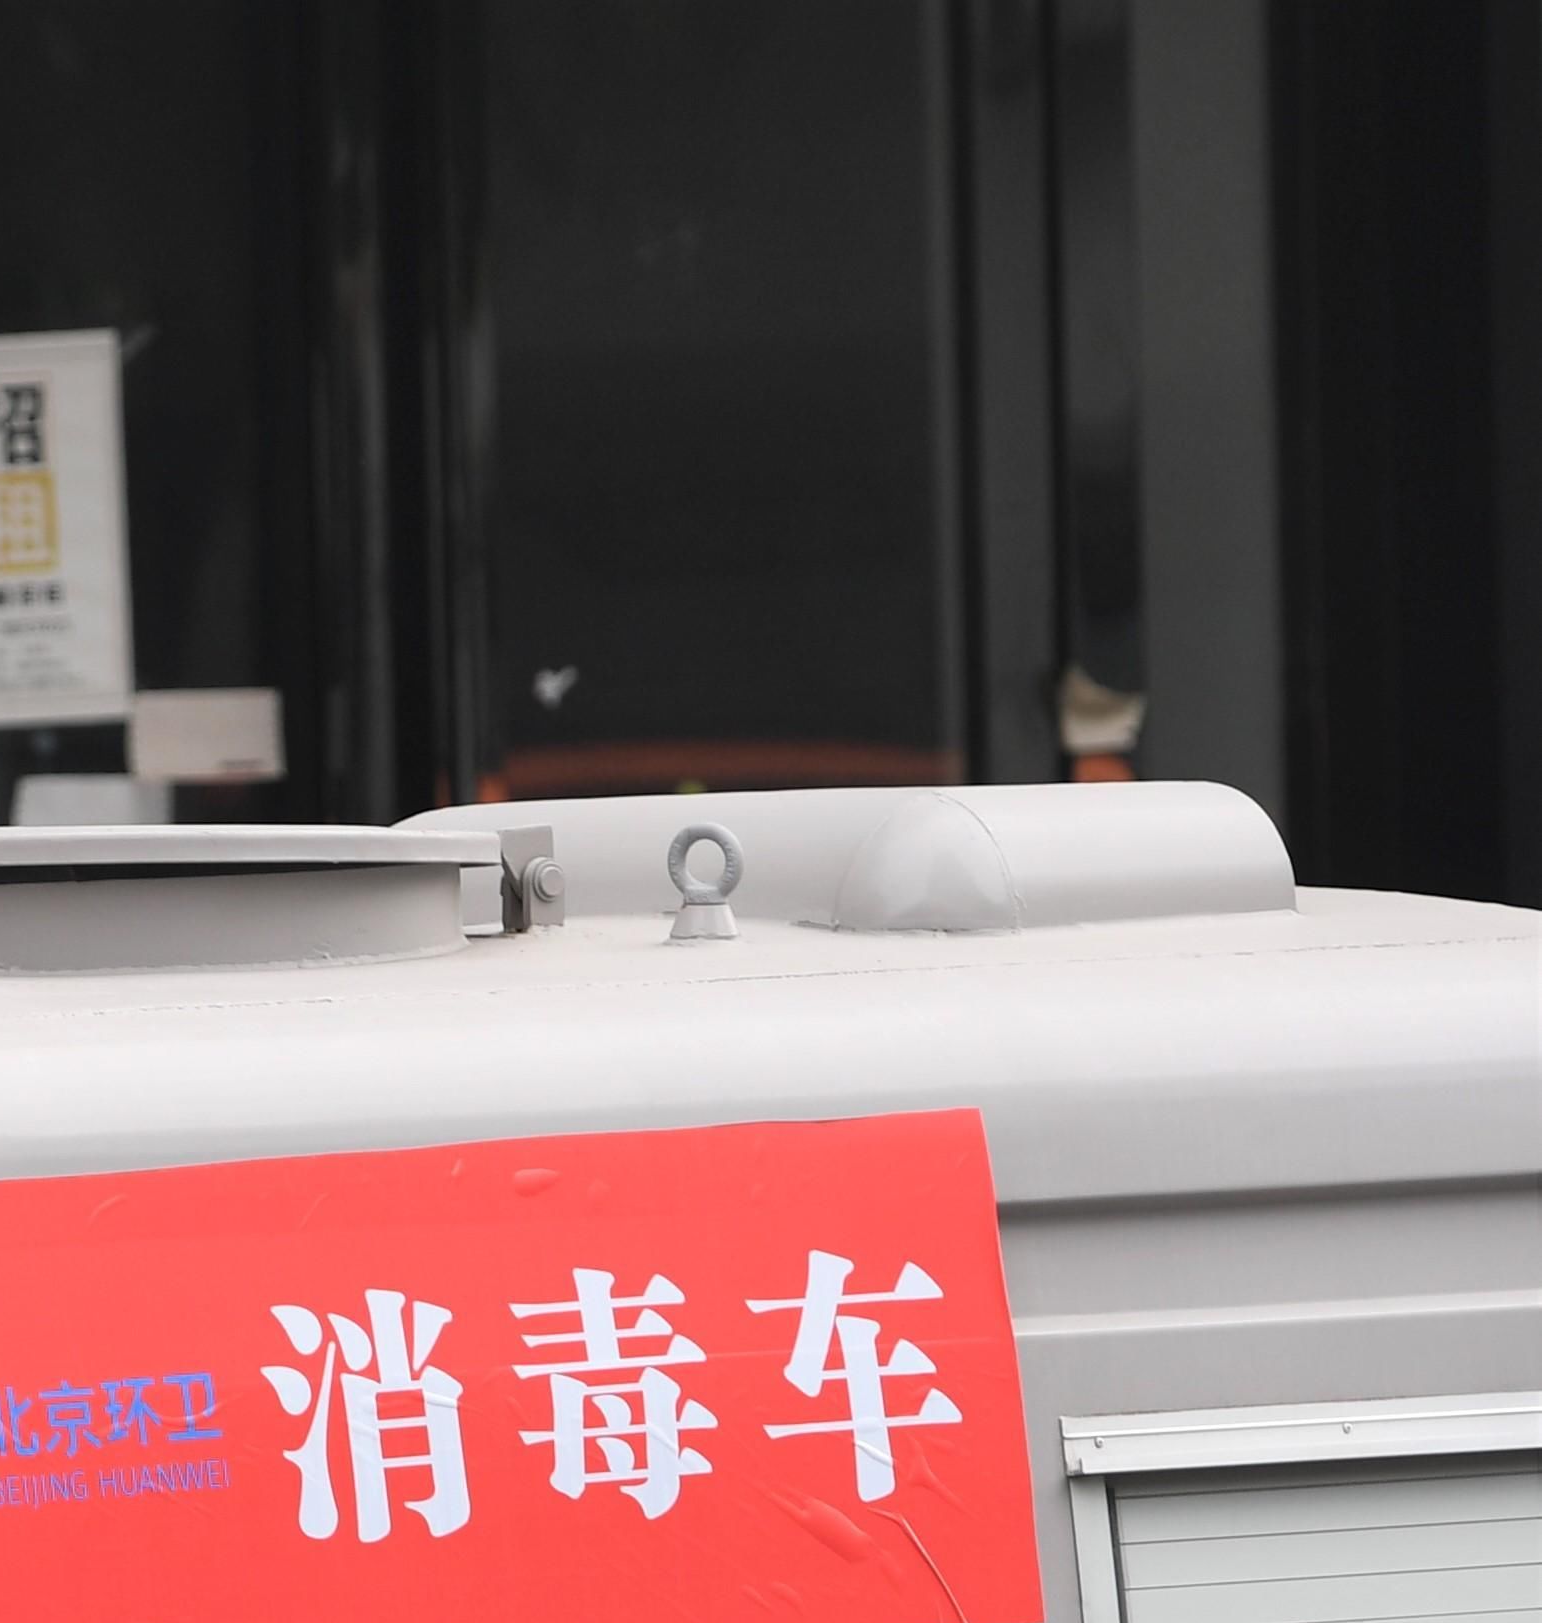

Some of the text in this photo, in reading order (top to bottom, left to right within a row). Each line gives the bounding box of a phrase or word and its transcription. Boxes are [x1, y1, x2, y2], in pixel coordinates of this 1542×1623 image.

[97, 1458, 231, 1498] HUANWEI
[257, 1248, 964, 1543] 消毒车
